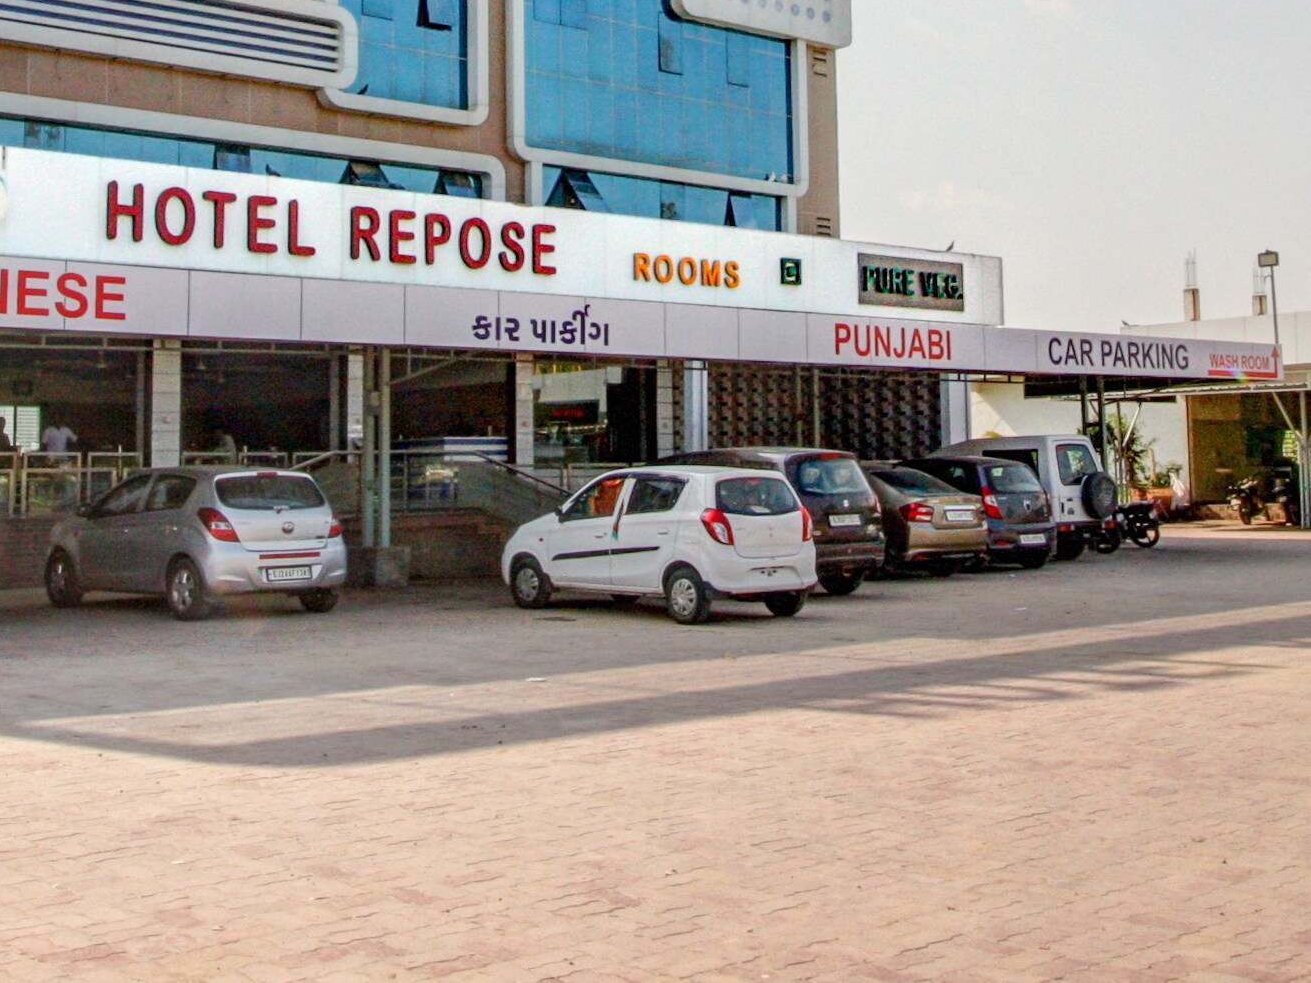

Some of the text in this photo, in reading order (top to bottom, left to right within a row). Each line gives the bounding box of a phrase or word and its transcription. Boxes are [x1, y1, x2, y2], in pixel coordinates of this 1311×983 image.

[106, 179, 557, 275] HOTEL REPOSE
[633, 253, 740, 288] ROOMS
[862, 266, 915, 296] PURE
[472, 315, 520, 341] કાર
[834, 323, 952, 362] PUNJABI
[1048, 337, 1188, 369] CAR PARKING
[1209, 353, 1269, 370] WASH ROOM
